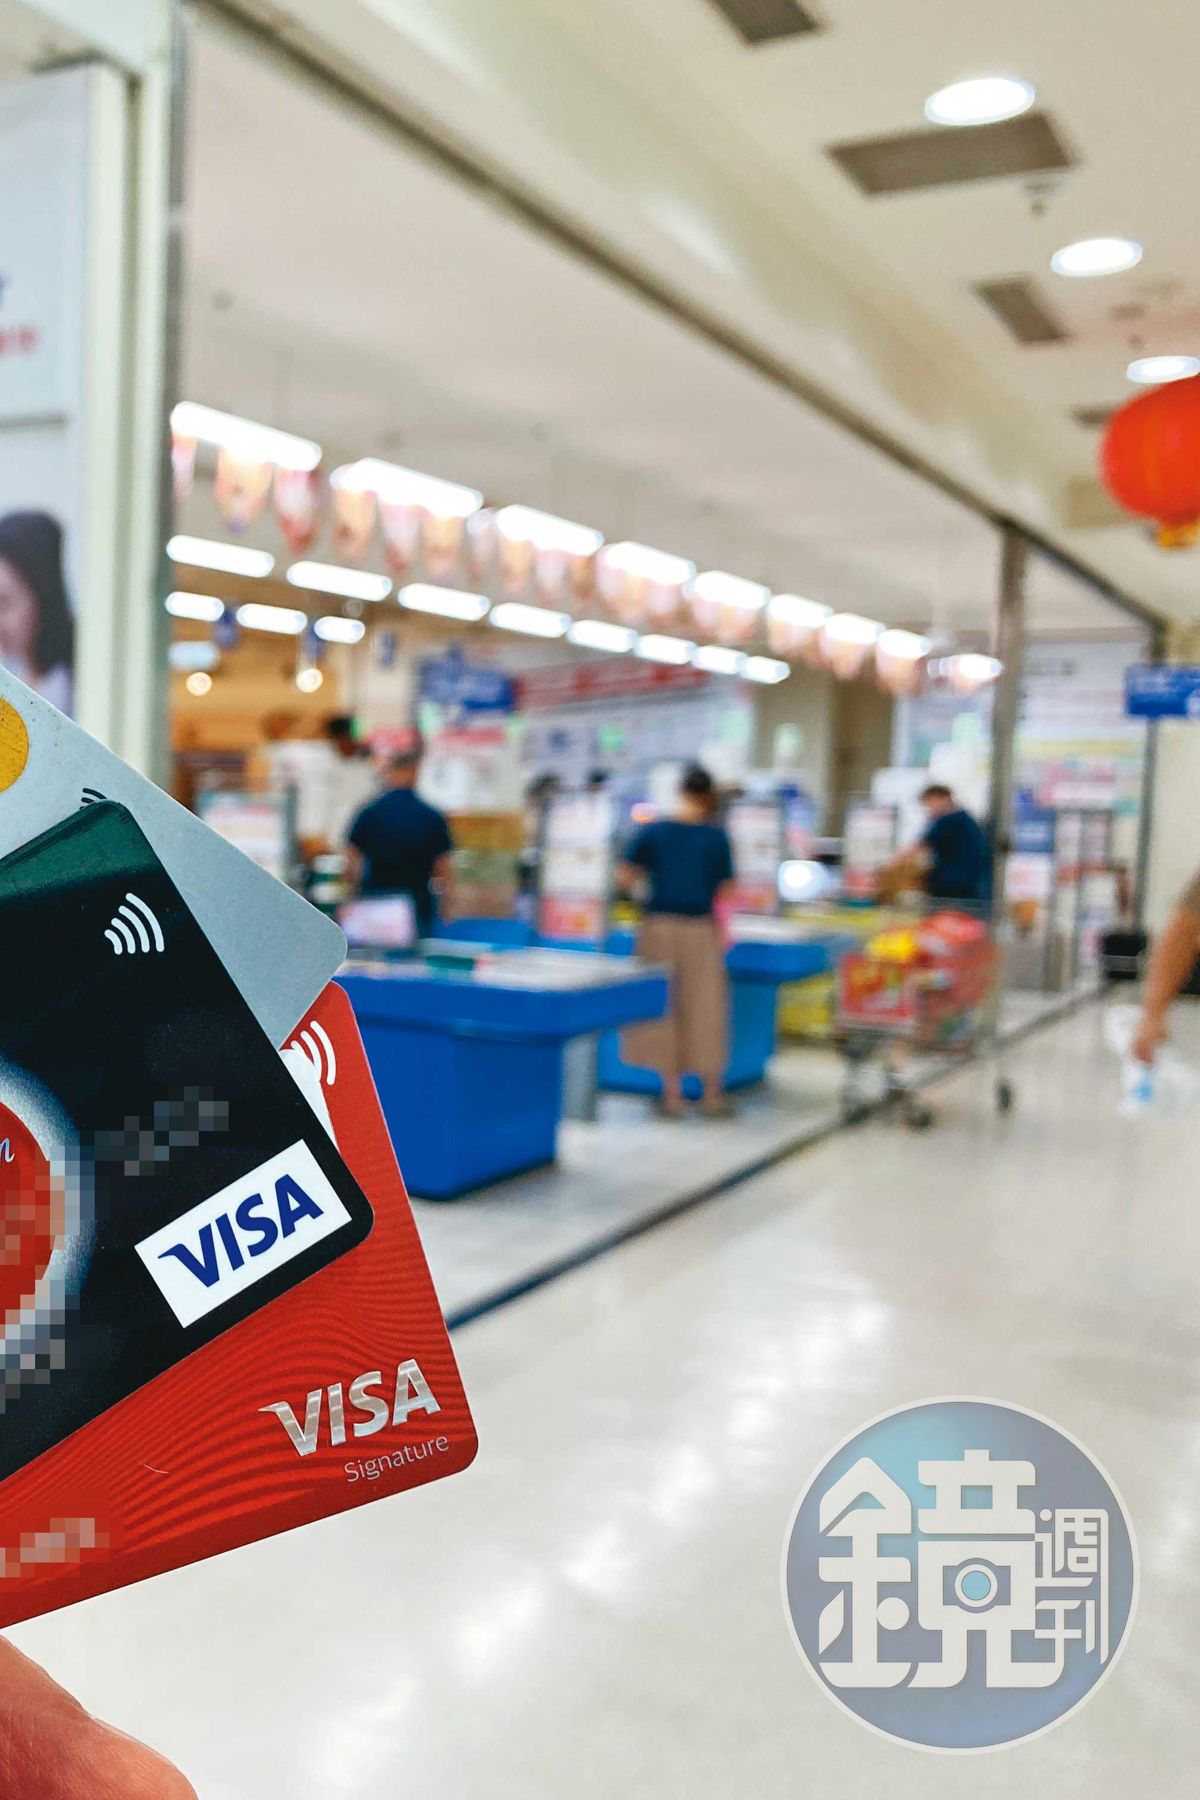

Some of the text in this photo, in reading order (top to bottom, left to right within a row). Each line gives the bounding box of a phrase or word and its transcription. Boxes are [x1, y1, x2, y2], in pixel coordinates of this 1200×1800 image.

[158, 1173, 325, 1288] VISA
[257, 1358, 442, 1457] VISA
[343, 1435, 450, 1483] Signature
